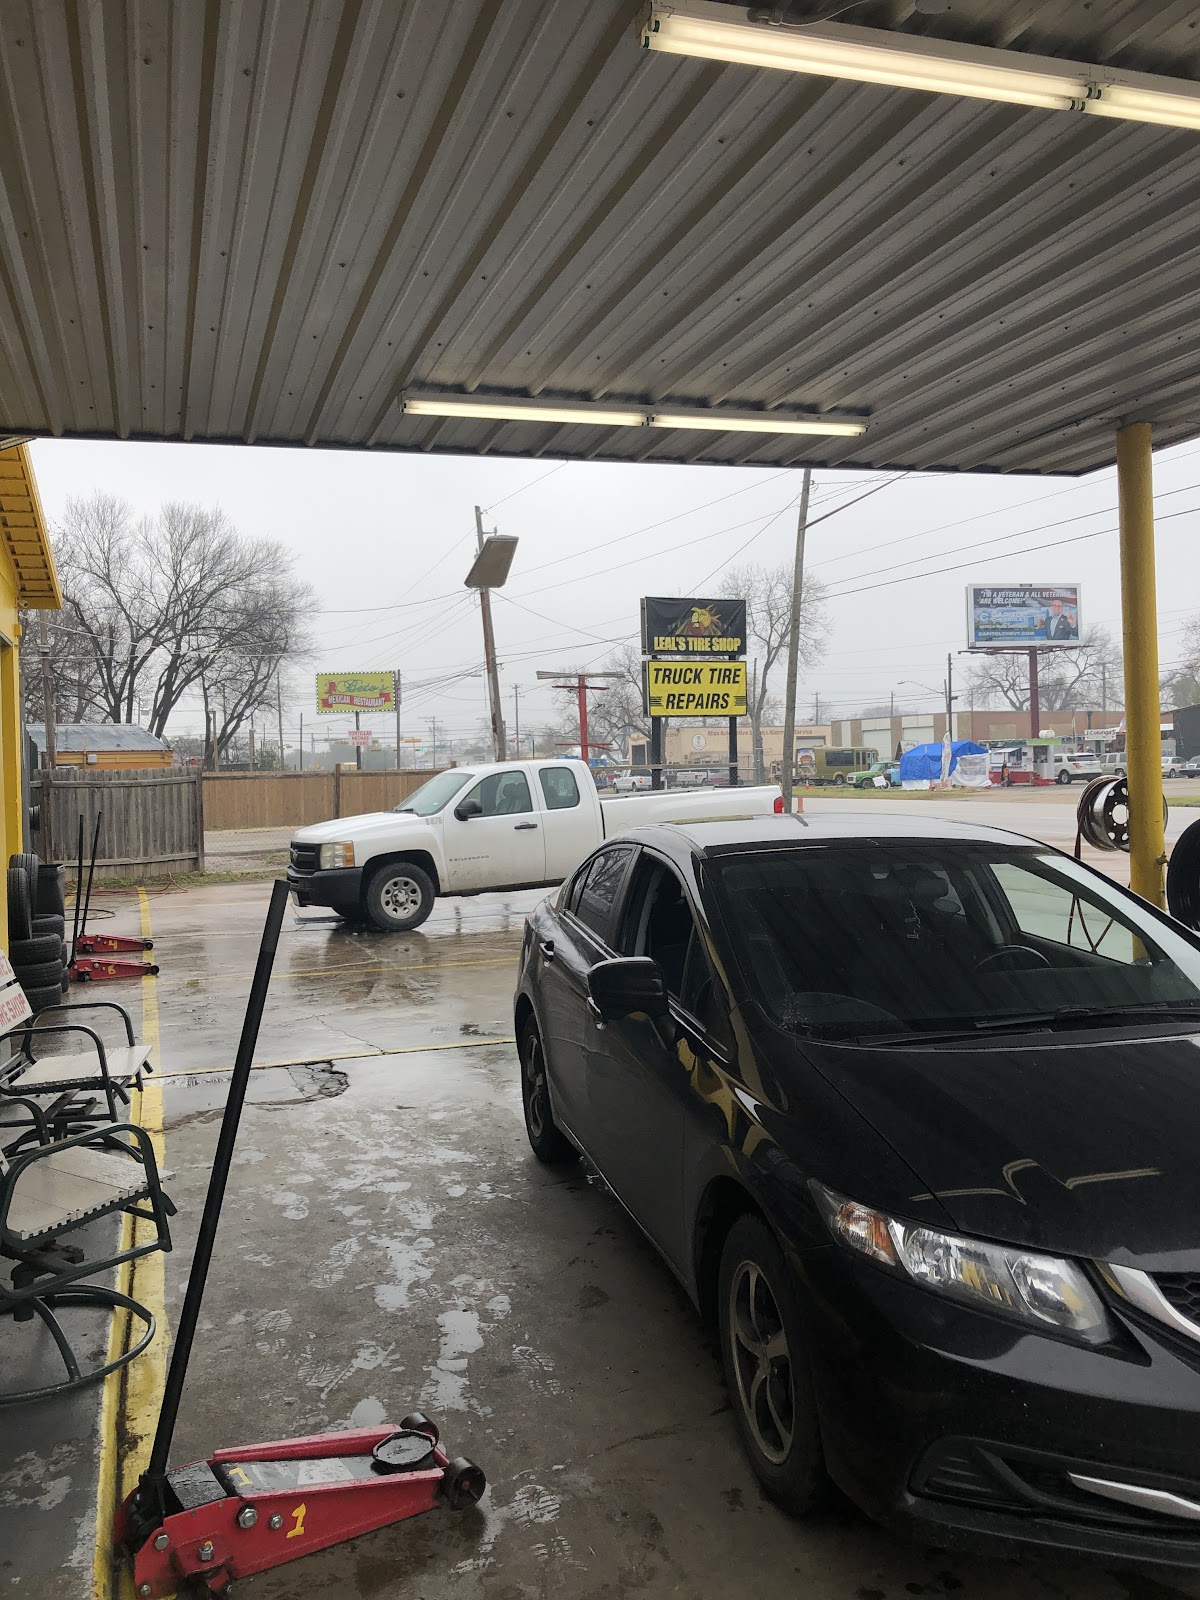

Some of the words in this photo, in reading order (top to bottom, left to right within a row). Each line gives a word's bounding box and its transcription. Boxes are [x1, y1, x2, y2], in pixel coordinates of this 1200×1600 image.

[653, 636, 686, 651] LEAL'S
[687, 637, 711, 651] TIRE
[712, 637, 742, 652] SHOP
[653, 667, 704, 684] TRUCK
[709, 668, 742, 684] TIRE
[328, 694, 351, 704] MEXICAN
[353, 696, 386, 707] RESTAURANT
[665, 692, 731, 710] REPAIRS
[108, 940, 118, 950] 4
[107, 964, 116, 974] 6
[286, 1503, 307, 1539] 1
